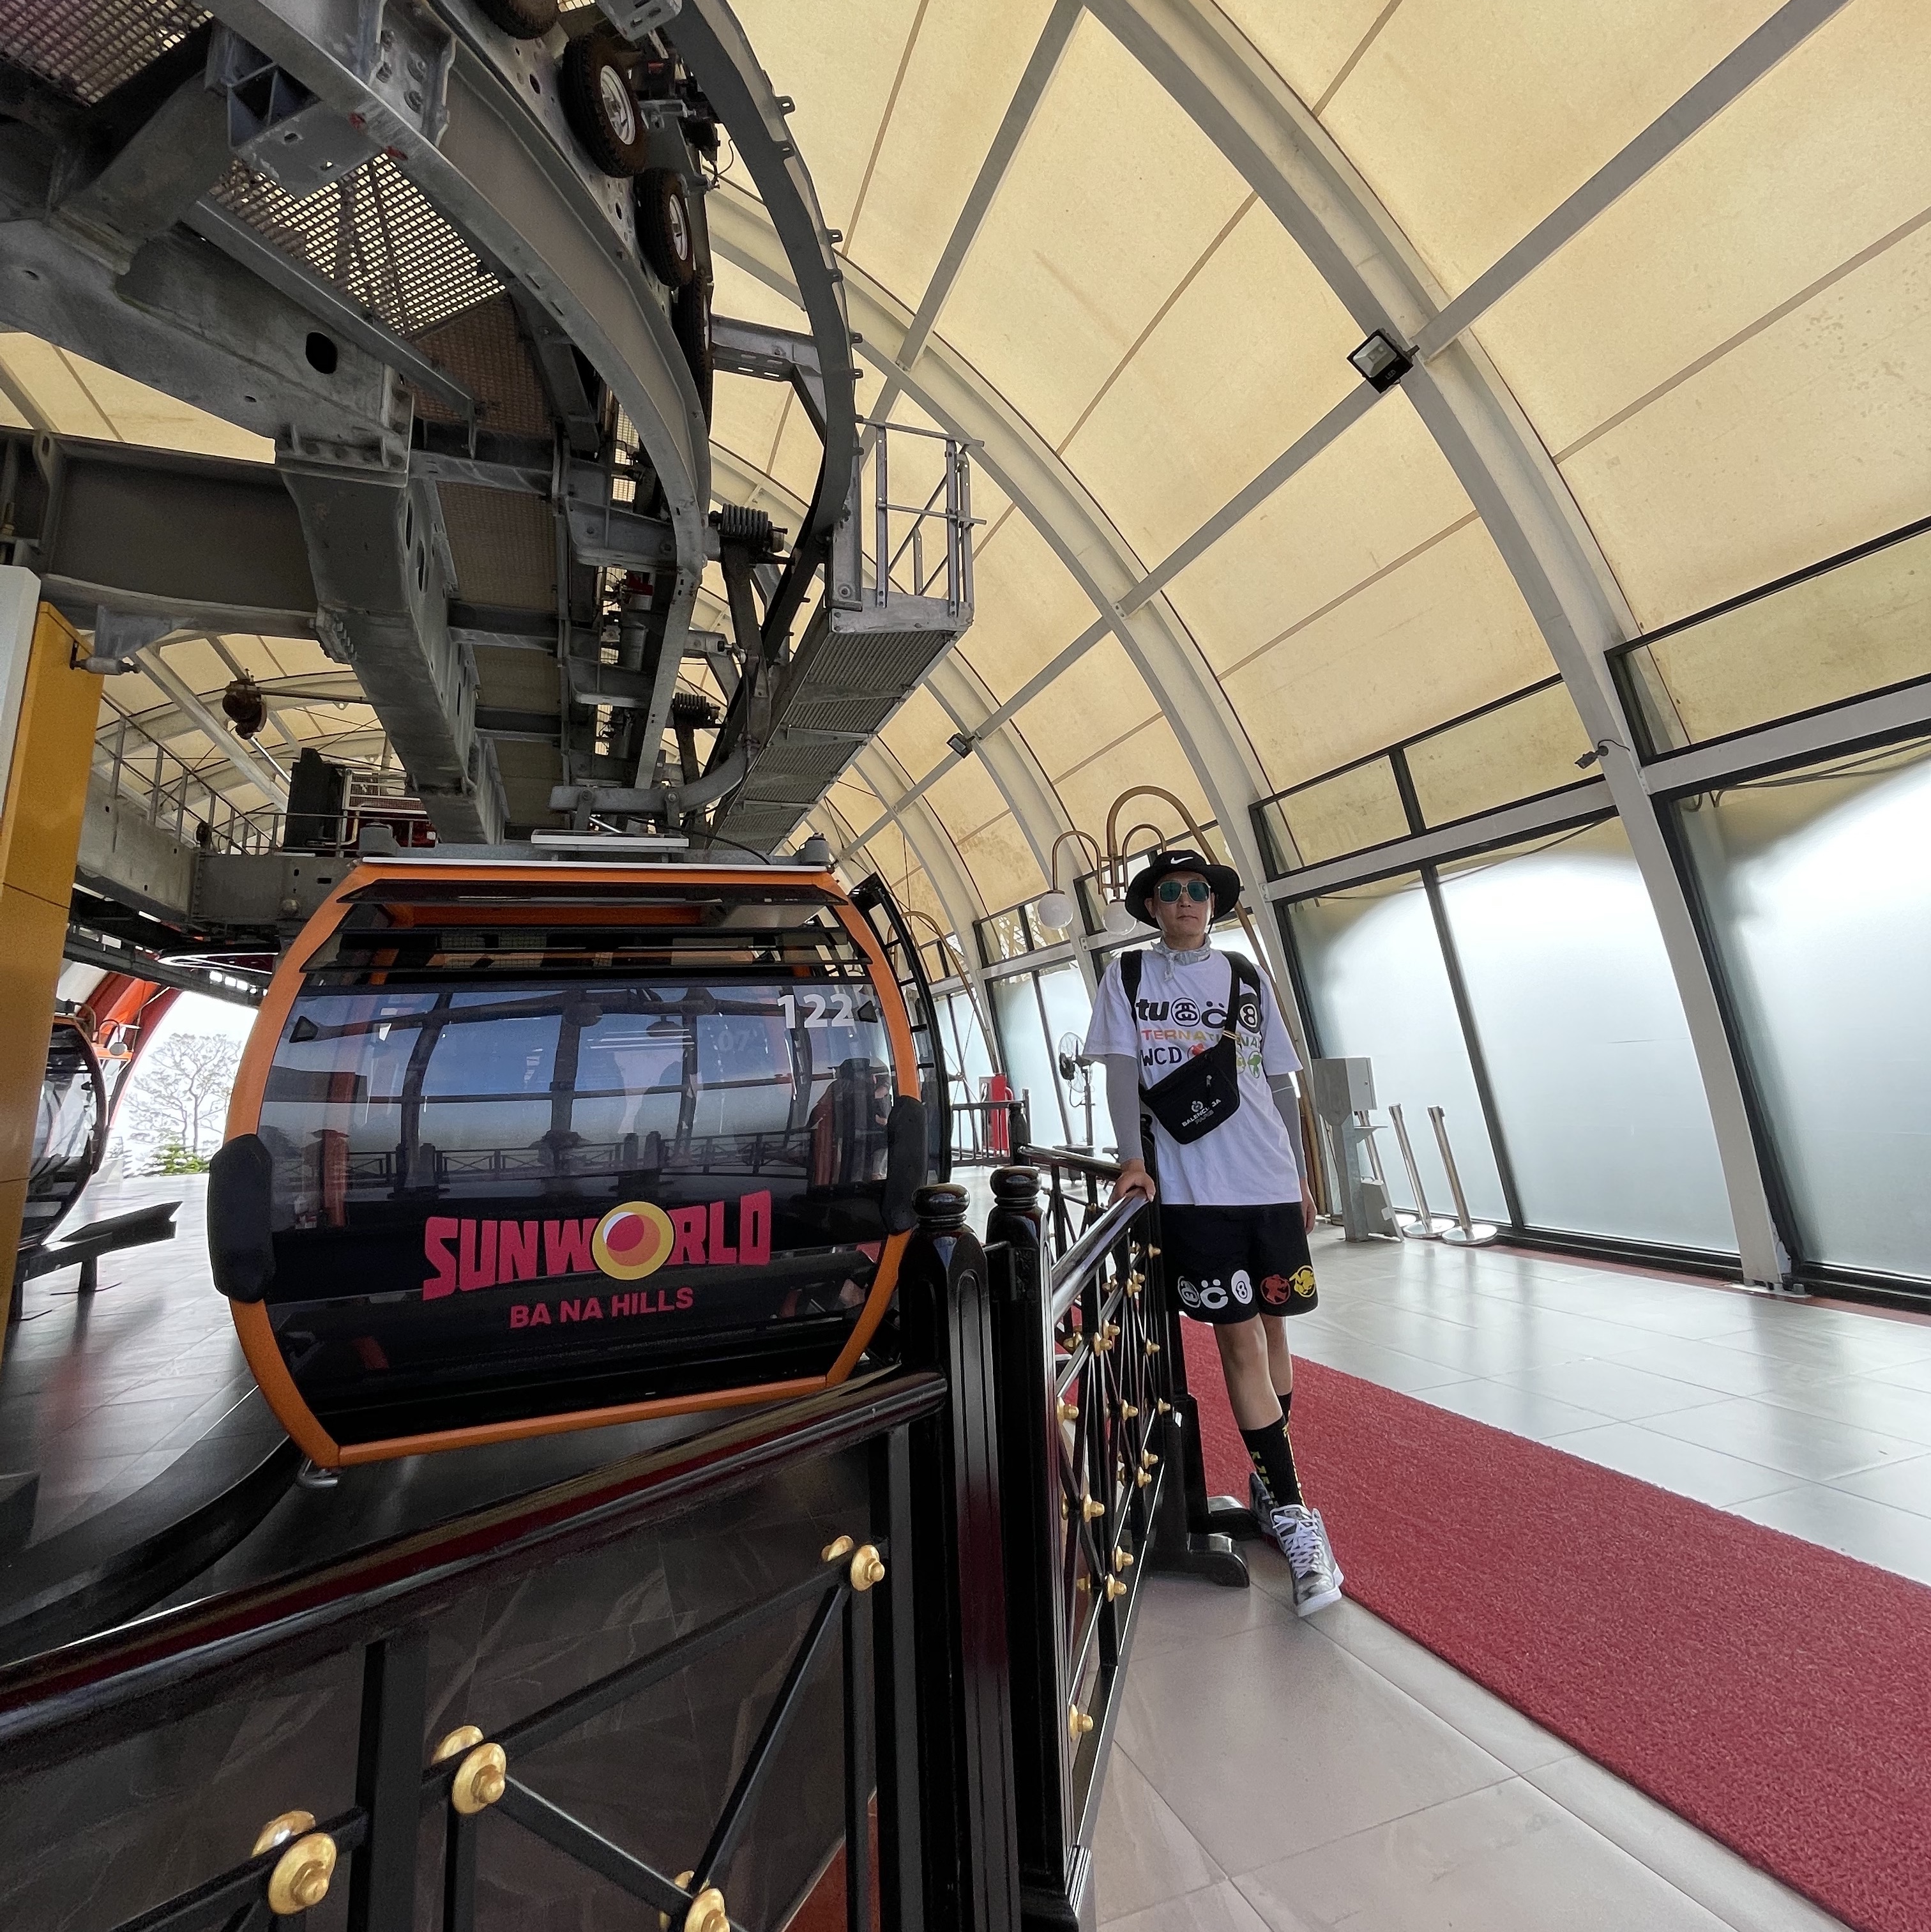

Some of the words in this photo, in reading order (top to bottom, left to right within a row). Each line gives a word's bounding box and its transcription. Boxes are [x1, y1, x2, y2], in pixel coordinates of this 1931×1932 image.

[777, 993, 854, 1029] 122
[510, 1305, 551, 1328] BA
[561, 1297, 602, 1323] NA
[611, 1286, 693, 1317] HILLS
